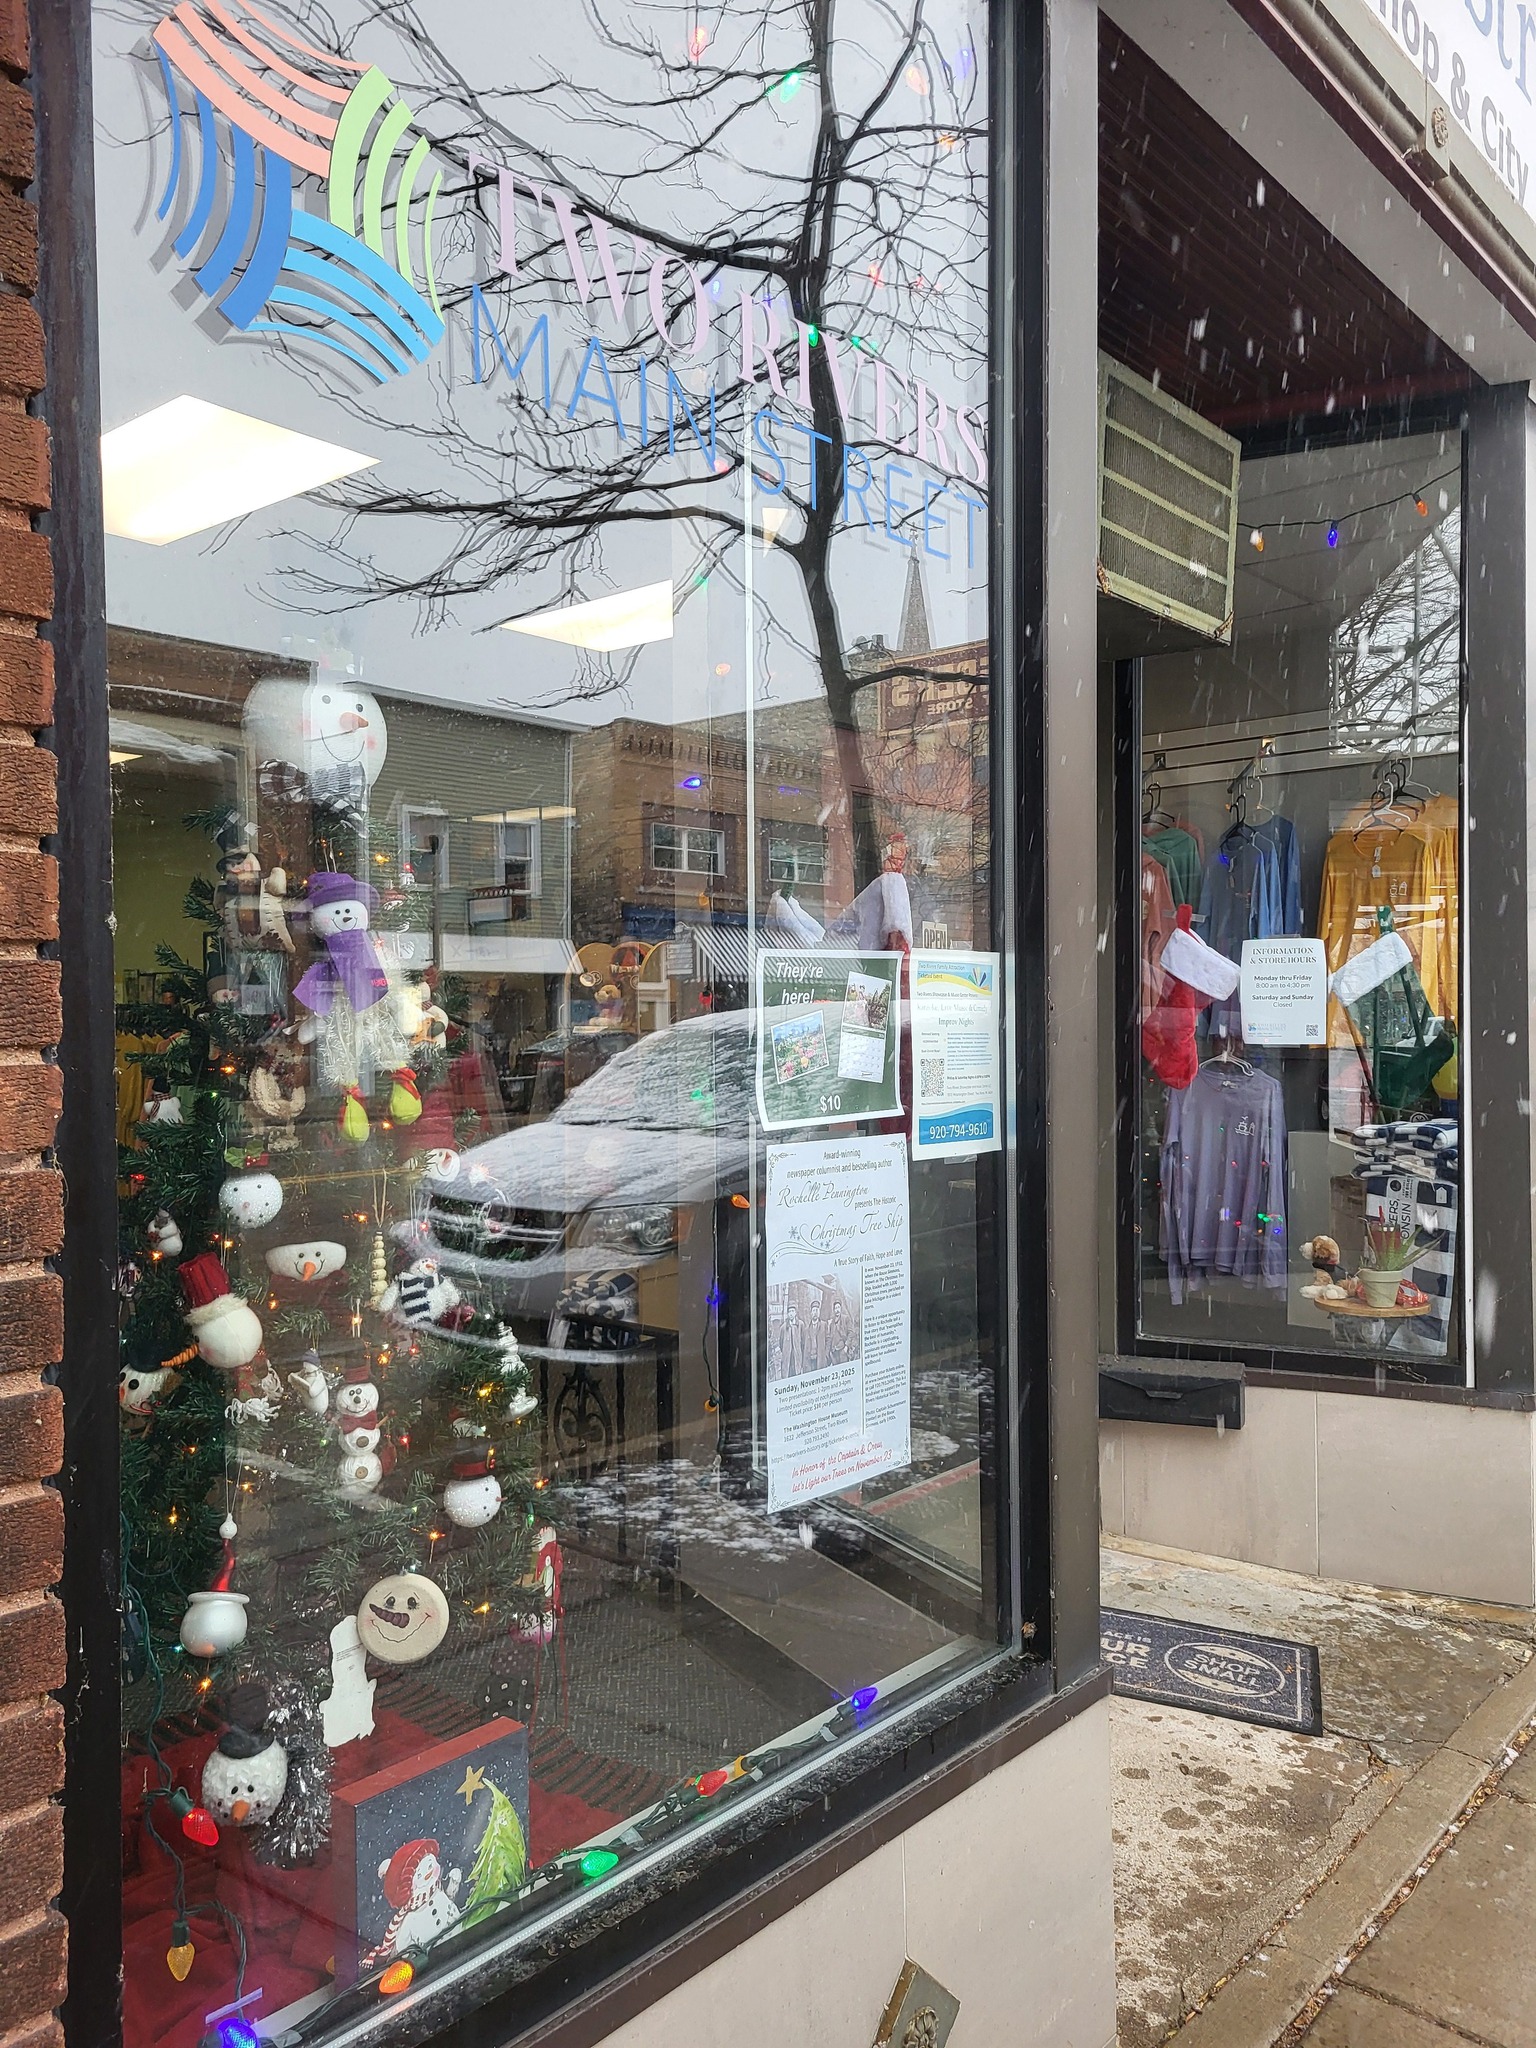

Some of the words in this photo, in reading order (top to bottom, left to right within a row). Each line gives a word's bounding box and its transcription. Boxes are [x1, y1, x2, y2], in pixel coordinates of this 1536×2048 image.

[1450, 52, 1472, 133] &
[1481, 95, 1529, 206] City
[468, 151, 710, 356] TWO
[738, 288, 987, 485] RIVERS
[472, 283, 716, 472] MAIN
[753, 409, 985, 569] STREET
[923, 929, 947, 949] OPEN
[1252, 947, 1314, 955] INFORMATION
[1258, 957, 1287, 965] STORE
[1287, 956, 1317, 964] HOURS
[775, 961, 824, 982] They're
[1293, 974, 1313, 982] Friday
[782, 988, 815, 1005] here!
[820, 1095, 841, 1113] $10
[929, 1122, 988, 1140] 920-794-9610
[823, 1149, 861, 1160] Award-winning
[786, 1168, 815, 1179] newspaper
[816, 1165, 841, 1176] columnist
[841, 1163, 852, 1172] and
[852, 1161, 877, 1172] bestselling
[877, 1159, 893, 1168] author
[822, 1181, 869, 1208] Pennington
[854, 1199, 873, 1210] presents
[873, 1197, 881, 1206] The
[881, 1196, 897, 1205] Historic
[810, 1213, 858, 1242] Christmas
[860, 1210, 882, 1234] Tree
[884, 1203, 903, 1242] Ship
[833, 1259, 838, 1267] A
[838, 1258, 848, 1266] True
[847, 1256, 859, 1266] Story
[859, 1255, 864, 1263] of
[876, 1251, 886, 1261] Hope
[886, 1249, 894, 1257] and
[894, 1248, 903, 1256] Love
[774, 1383, 800, 1396] Sunday,
[800, 1375, 831, 1389] November
[831, 1371, 841, 1380] 23,
[840, 1367, 856, 1378] 2025
[793, 1419, 818, 1431] Washington
[817, 1415, 831, 1423] House
[830, 1410, 848, 1418] Museum
[791, 1467, 799, 1478] In
[799, 1463, 819, 1477] Honor
[837, 1448, 860, 1463] Captain
[804, 1475, 820, 1490] Light
[832, 1468, 847, 1479] Trees
[855, 1455, 883, 1472] November
[883, 1448, 893, 1461] 23
[1101, 1637, 1151, 1657] UR
[1137, 1635, 1152, 1644] IS
[1101, 1652, 1149, 1670] CE
[1194, 1653, 1260, 1676] SHOP
[1183, 1659, 1261, 1687] SMALL
